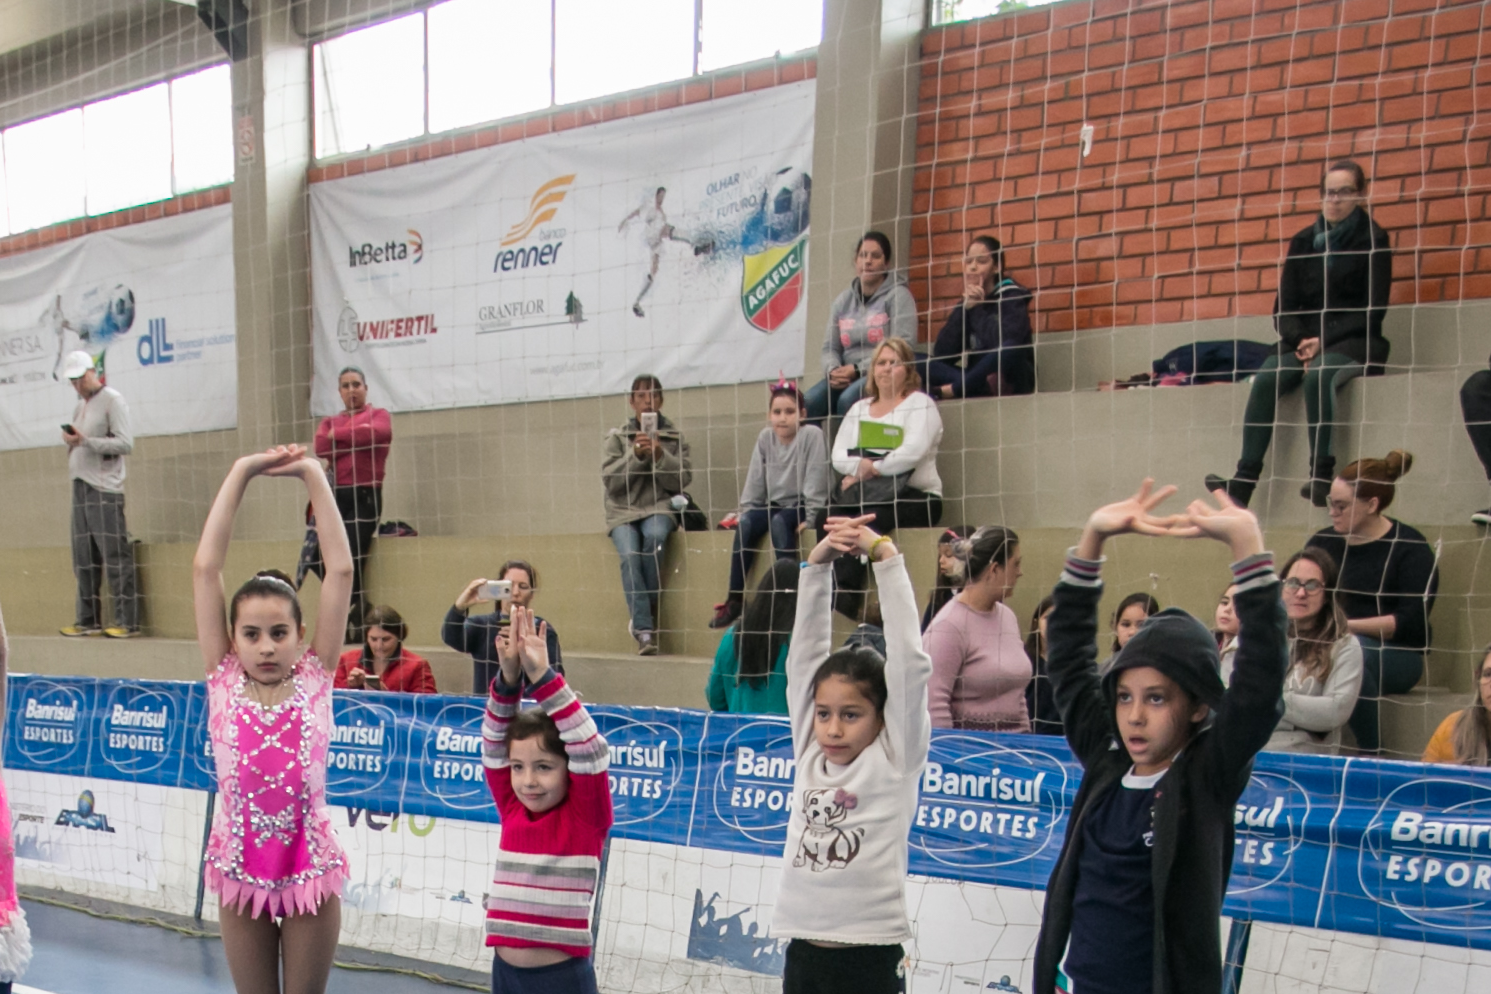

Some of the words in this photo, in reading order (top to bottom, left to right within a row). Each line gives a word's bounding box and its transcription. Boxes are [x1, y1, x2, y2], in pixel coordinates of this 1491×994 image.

[706, 172, 740, 196] OLHAR
[493, 242, 562, 273] renner
[748, 254, 800, 310] AGAFUC
[479, 299, 544, 322] GRANFLOR
[25, 698, 78, 722] Banrisul
[111, 704, 167, 729] Banrisul
[24, 726, 75, 745] ESPORTES
[110, 732, 164, 753] ESPORTES
[330, 719, 385, 746] anrisul
[436, 726, 484, 754] Banr
[328, 751, 382, 773] PORTES
[608, 740, 667, 768] nrisul
[736, 746, 796, 780] Banr
[433, 760, 485, 783] ESPOR
[922, 762, 1046, 803] Banrisul
[731, 786, 794, 813] ESPOR
[916, 805, 1039, 839] ESPORTES
[1390, 811, 1491, 849] Banr
[1386, 854, 1491, 891] ESPOR
